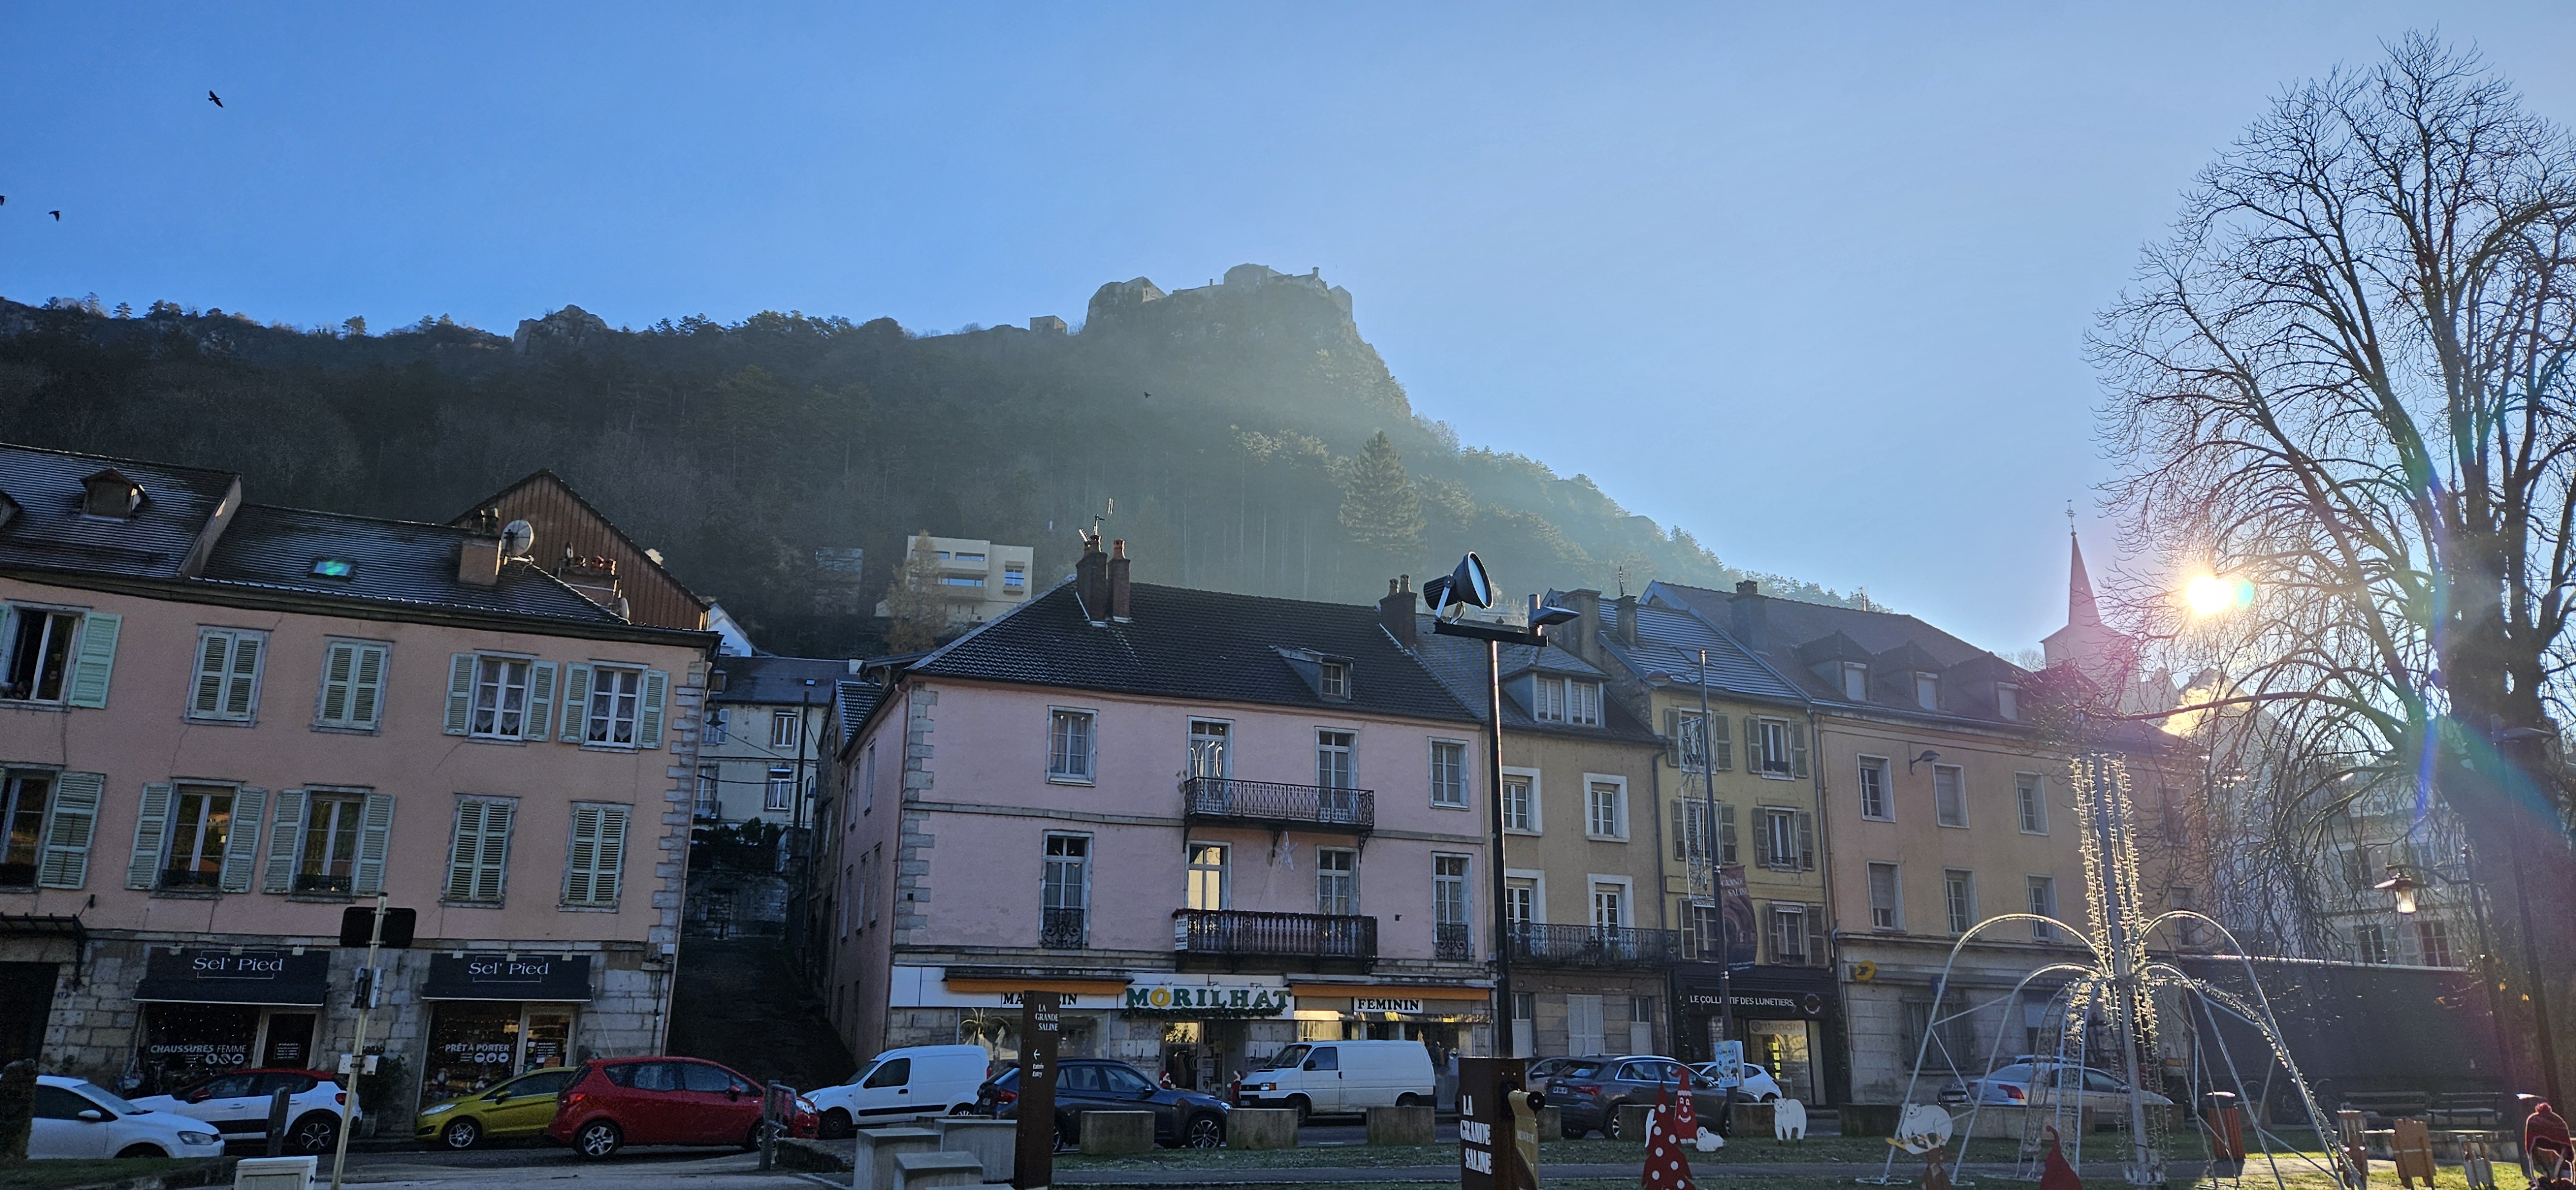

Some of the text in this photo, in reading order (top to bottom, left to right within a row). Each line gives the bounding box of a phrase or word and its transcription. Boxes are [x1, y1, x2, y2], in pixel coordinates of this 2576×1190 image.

[192, 956, 283, 972] Sel' Pied
[468, 962, 549, 976] Sel' Pied
[1123, 987, 1292, 1008] MORILHAT
[1690, 995, 1700, 1004] LE
[1740, 997, 1754, 1005] DES
[1755, 997, 1794, 1006] LUNETIERS
[1039, 1004, 1046, 1012] LA
[1357, 998, 1419, 1011] FEMININ
[1035, 1013, 1059, 1022] GRANDE
[1038, 1023, 1058, 1032] SALINE
[149, 1044, 247, 1054] CHAUSSURES FEMME
[444, 1043, 468, 1052] PRÊT
[475, 1043, 510, 1052] PORTER
[1463, 1095, 1473, 1116] LA
[1460, 1120, 1492, 1146] GRANDE
[1465, 1148, 1492, 1175] SALINE
